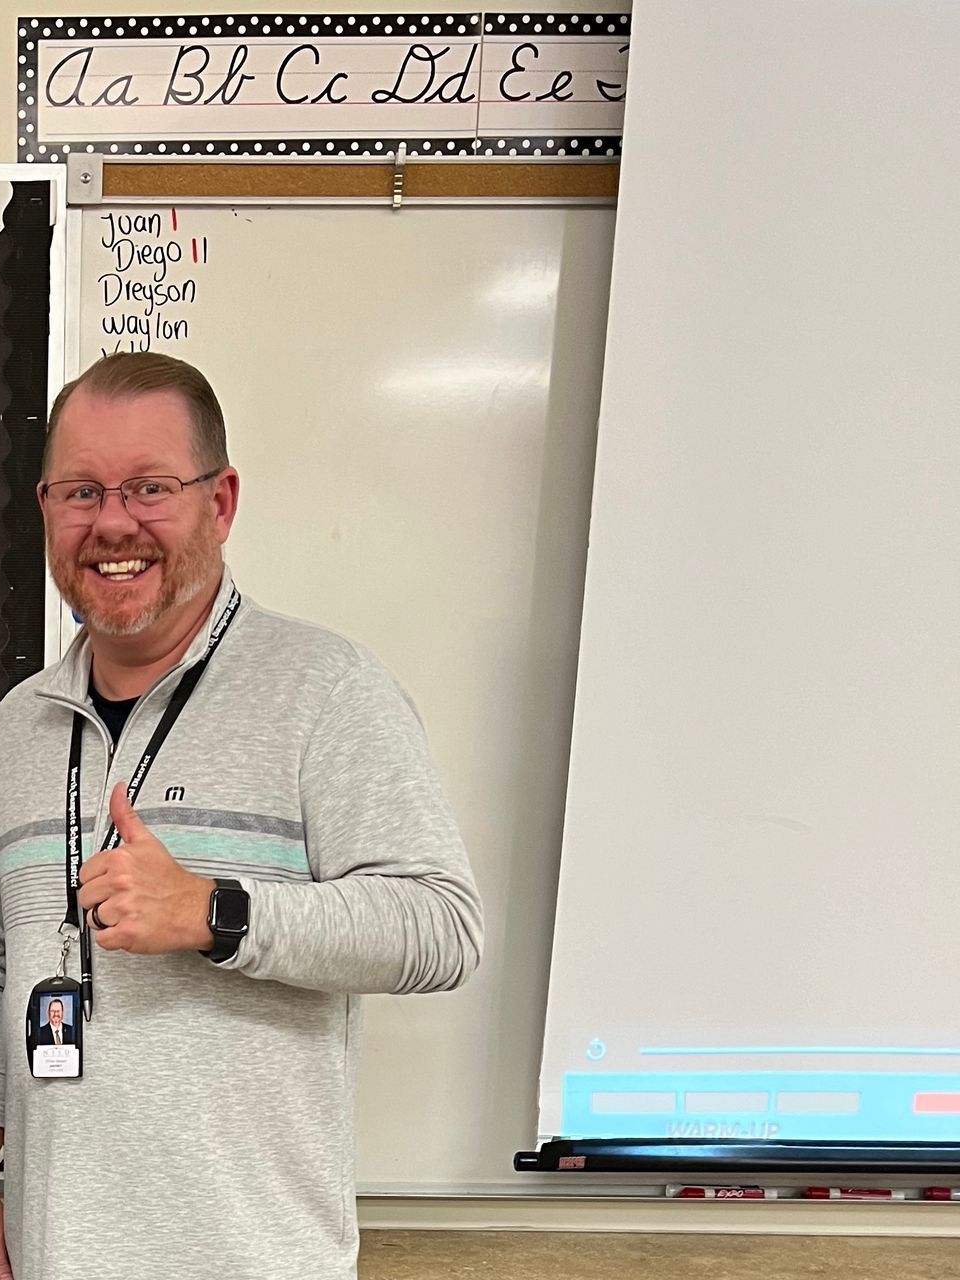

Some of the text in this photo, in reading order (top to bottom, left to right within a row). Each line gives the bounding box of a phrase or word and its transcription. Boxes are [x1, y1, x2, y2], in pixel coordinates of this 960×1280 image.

[45, 46, 139, 107] Aa
[162, 44, 256, 106] Bb
[275, 43, 350, 105] Cc
[372, 42, 478, 104] Dd
[499, 42, 575, 102] Ee
[112, 239, 182, 282] Diego
[97, 273, 196, 316] Dreyson
[131, 754, 151, 789] District
[69, 825, 79, 856] School
[70, 856, 79, 888] District
[666, 1120, 780, 1138] WARM-UP
[716, 1188, 744, 1199] EXPO
